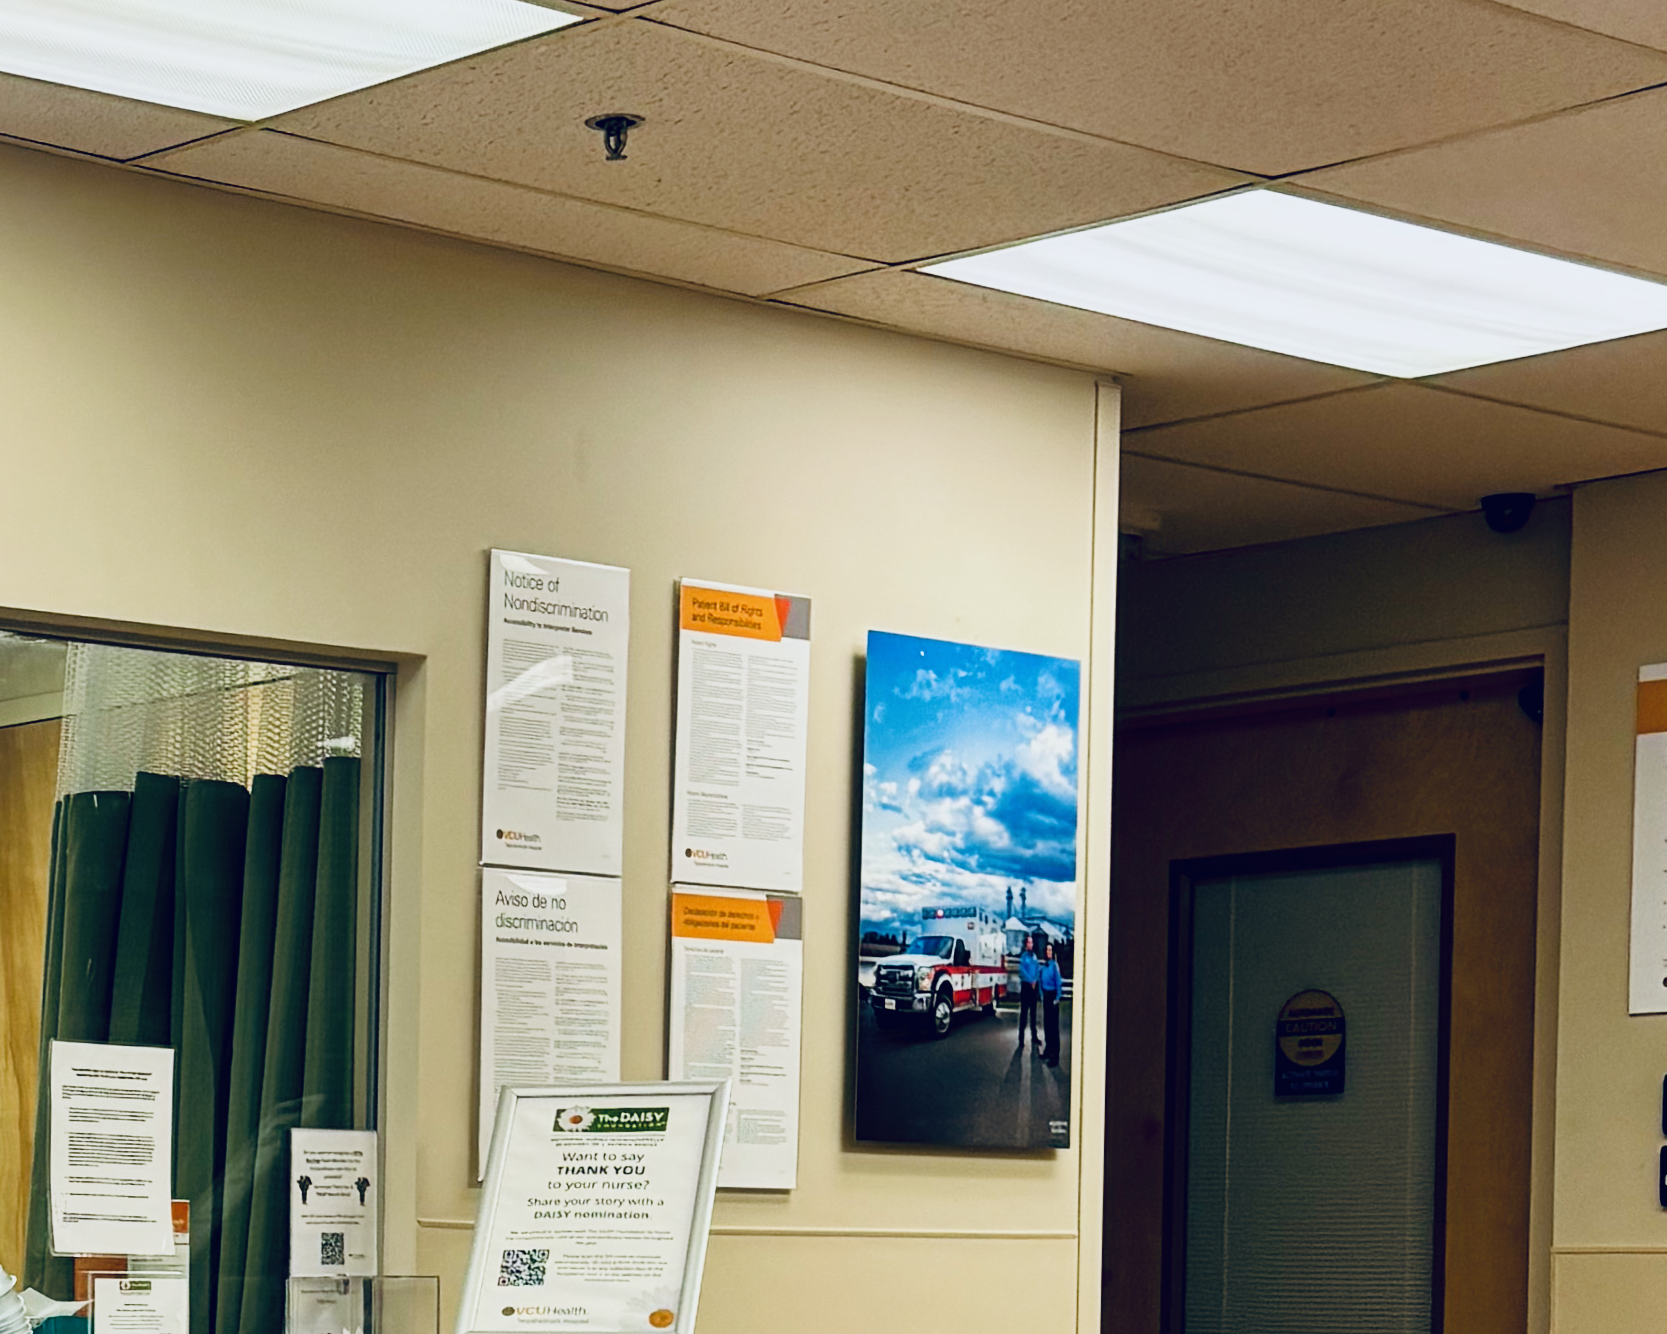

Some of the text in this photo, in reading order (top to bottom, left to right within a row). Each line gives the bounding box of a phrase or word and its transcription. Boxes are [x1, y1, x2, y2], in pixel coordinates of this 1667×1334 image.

[504, 570, 560, 593] Notice of
[504, 593, 609, 622] Nondiscrimination
[692, 597, 717, 611] Patient
[740, 605, 763, 617] Rights
[692, 613, 706, 622] and
[495, 890, 567, 910] Aviso de no
[495, 912, 579, 933] discriminación
[1285, 1020, 1337, 1033] CAUTION
[598, 1111, 665, 1122] The DAISY
[563, 1152, 645, 1163] Want to say
[557, 1165, 646, 1176] THANK YOU
[548, 1180, 650, 1192] to your nurse?
[527, 1197, 664, 1208] Share your story with a
[533, 1210, 653, 1220] DAISY nomination.
